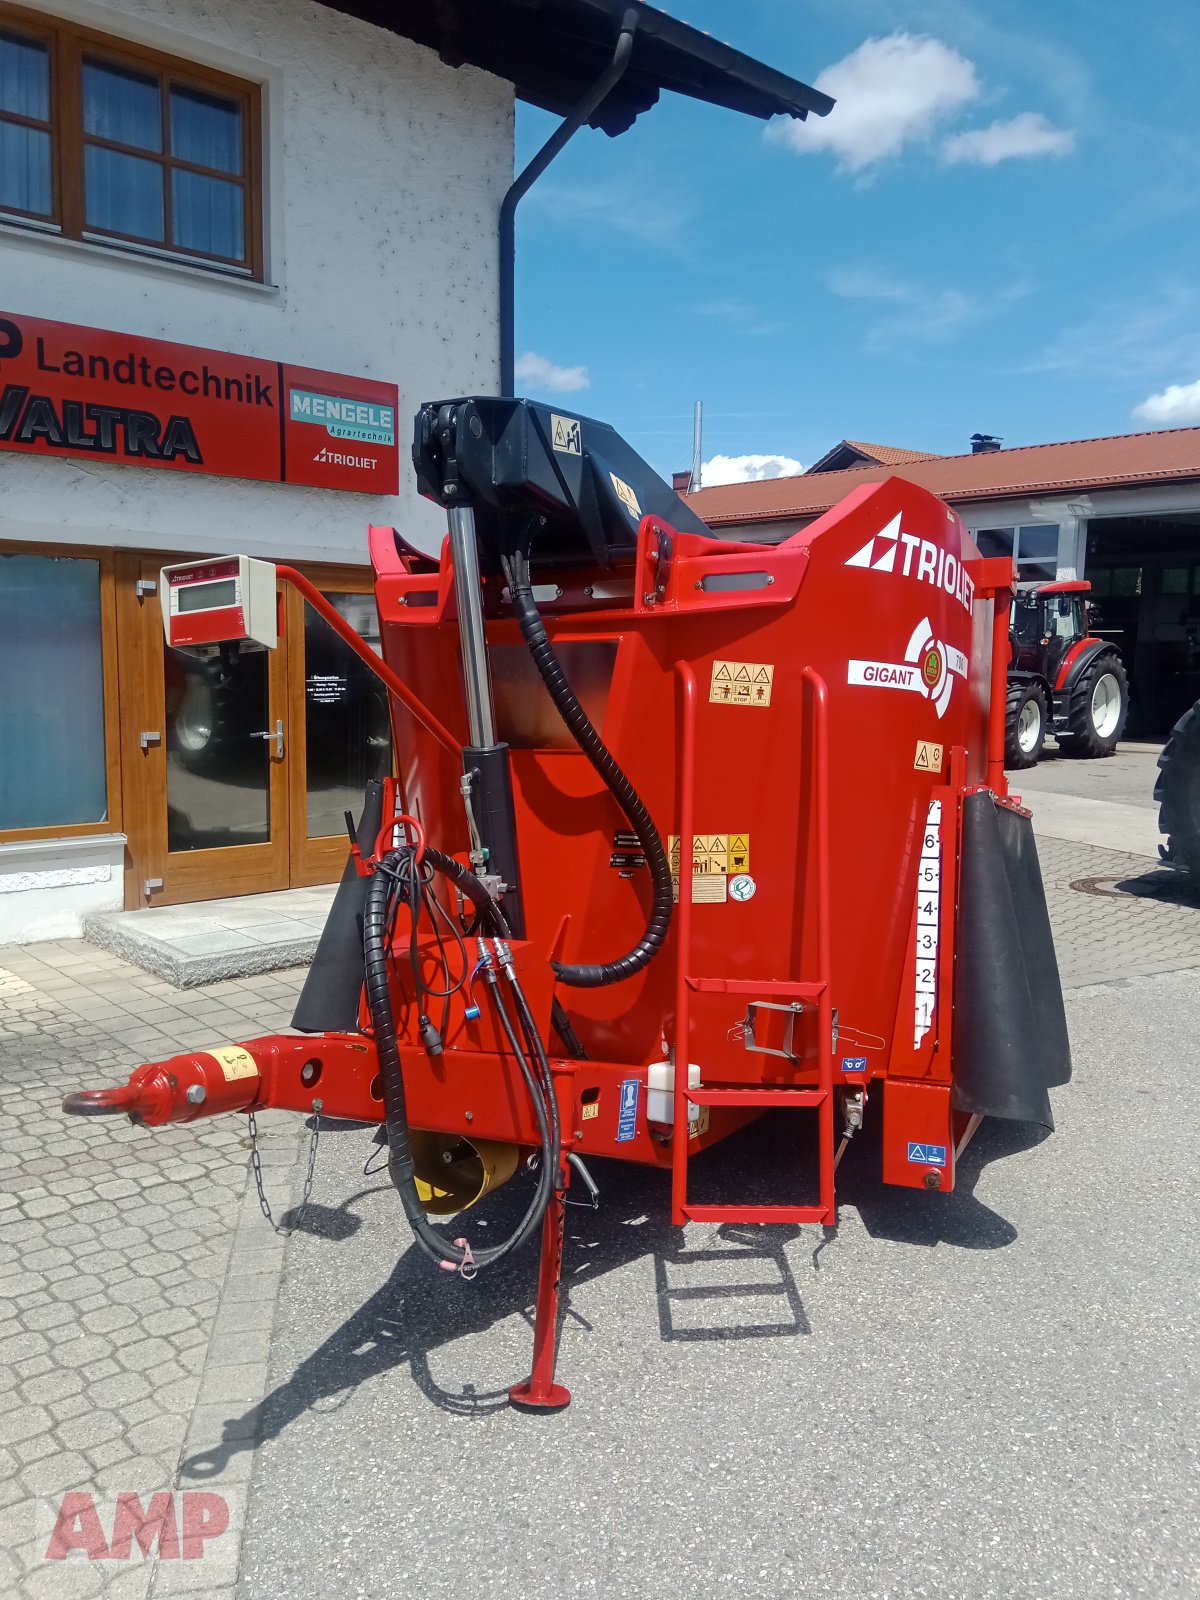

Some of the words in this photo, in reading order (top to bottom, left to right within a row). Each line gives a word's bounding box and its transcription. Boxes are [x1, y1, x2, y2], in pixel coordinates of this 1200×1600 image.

[36, 337, 274, 407] Landtechnik
[293, 394, 392, 428] MENGELE
[329, 426, 393, 443] Agrartechnik
[326, 452, 378, 470] TRIOLIET
[901, 532, 975, 617] TRIOLIET
[863, 666, 915, 686] GIGANT
[925, 835, 935, 848] 6
[924, 868, 934, 882] 5
[923, 901, 933, 916] 4
[922, 935, 932, 949] 3
[921, 968, 931, 983] 2
[921, 1003, 928, 1017] 1
